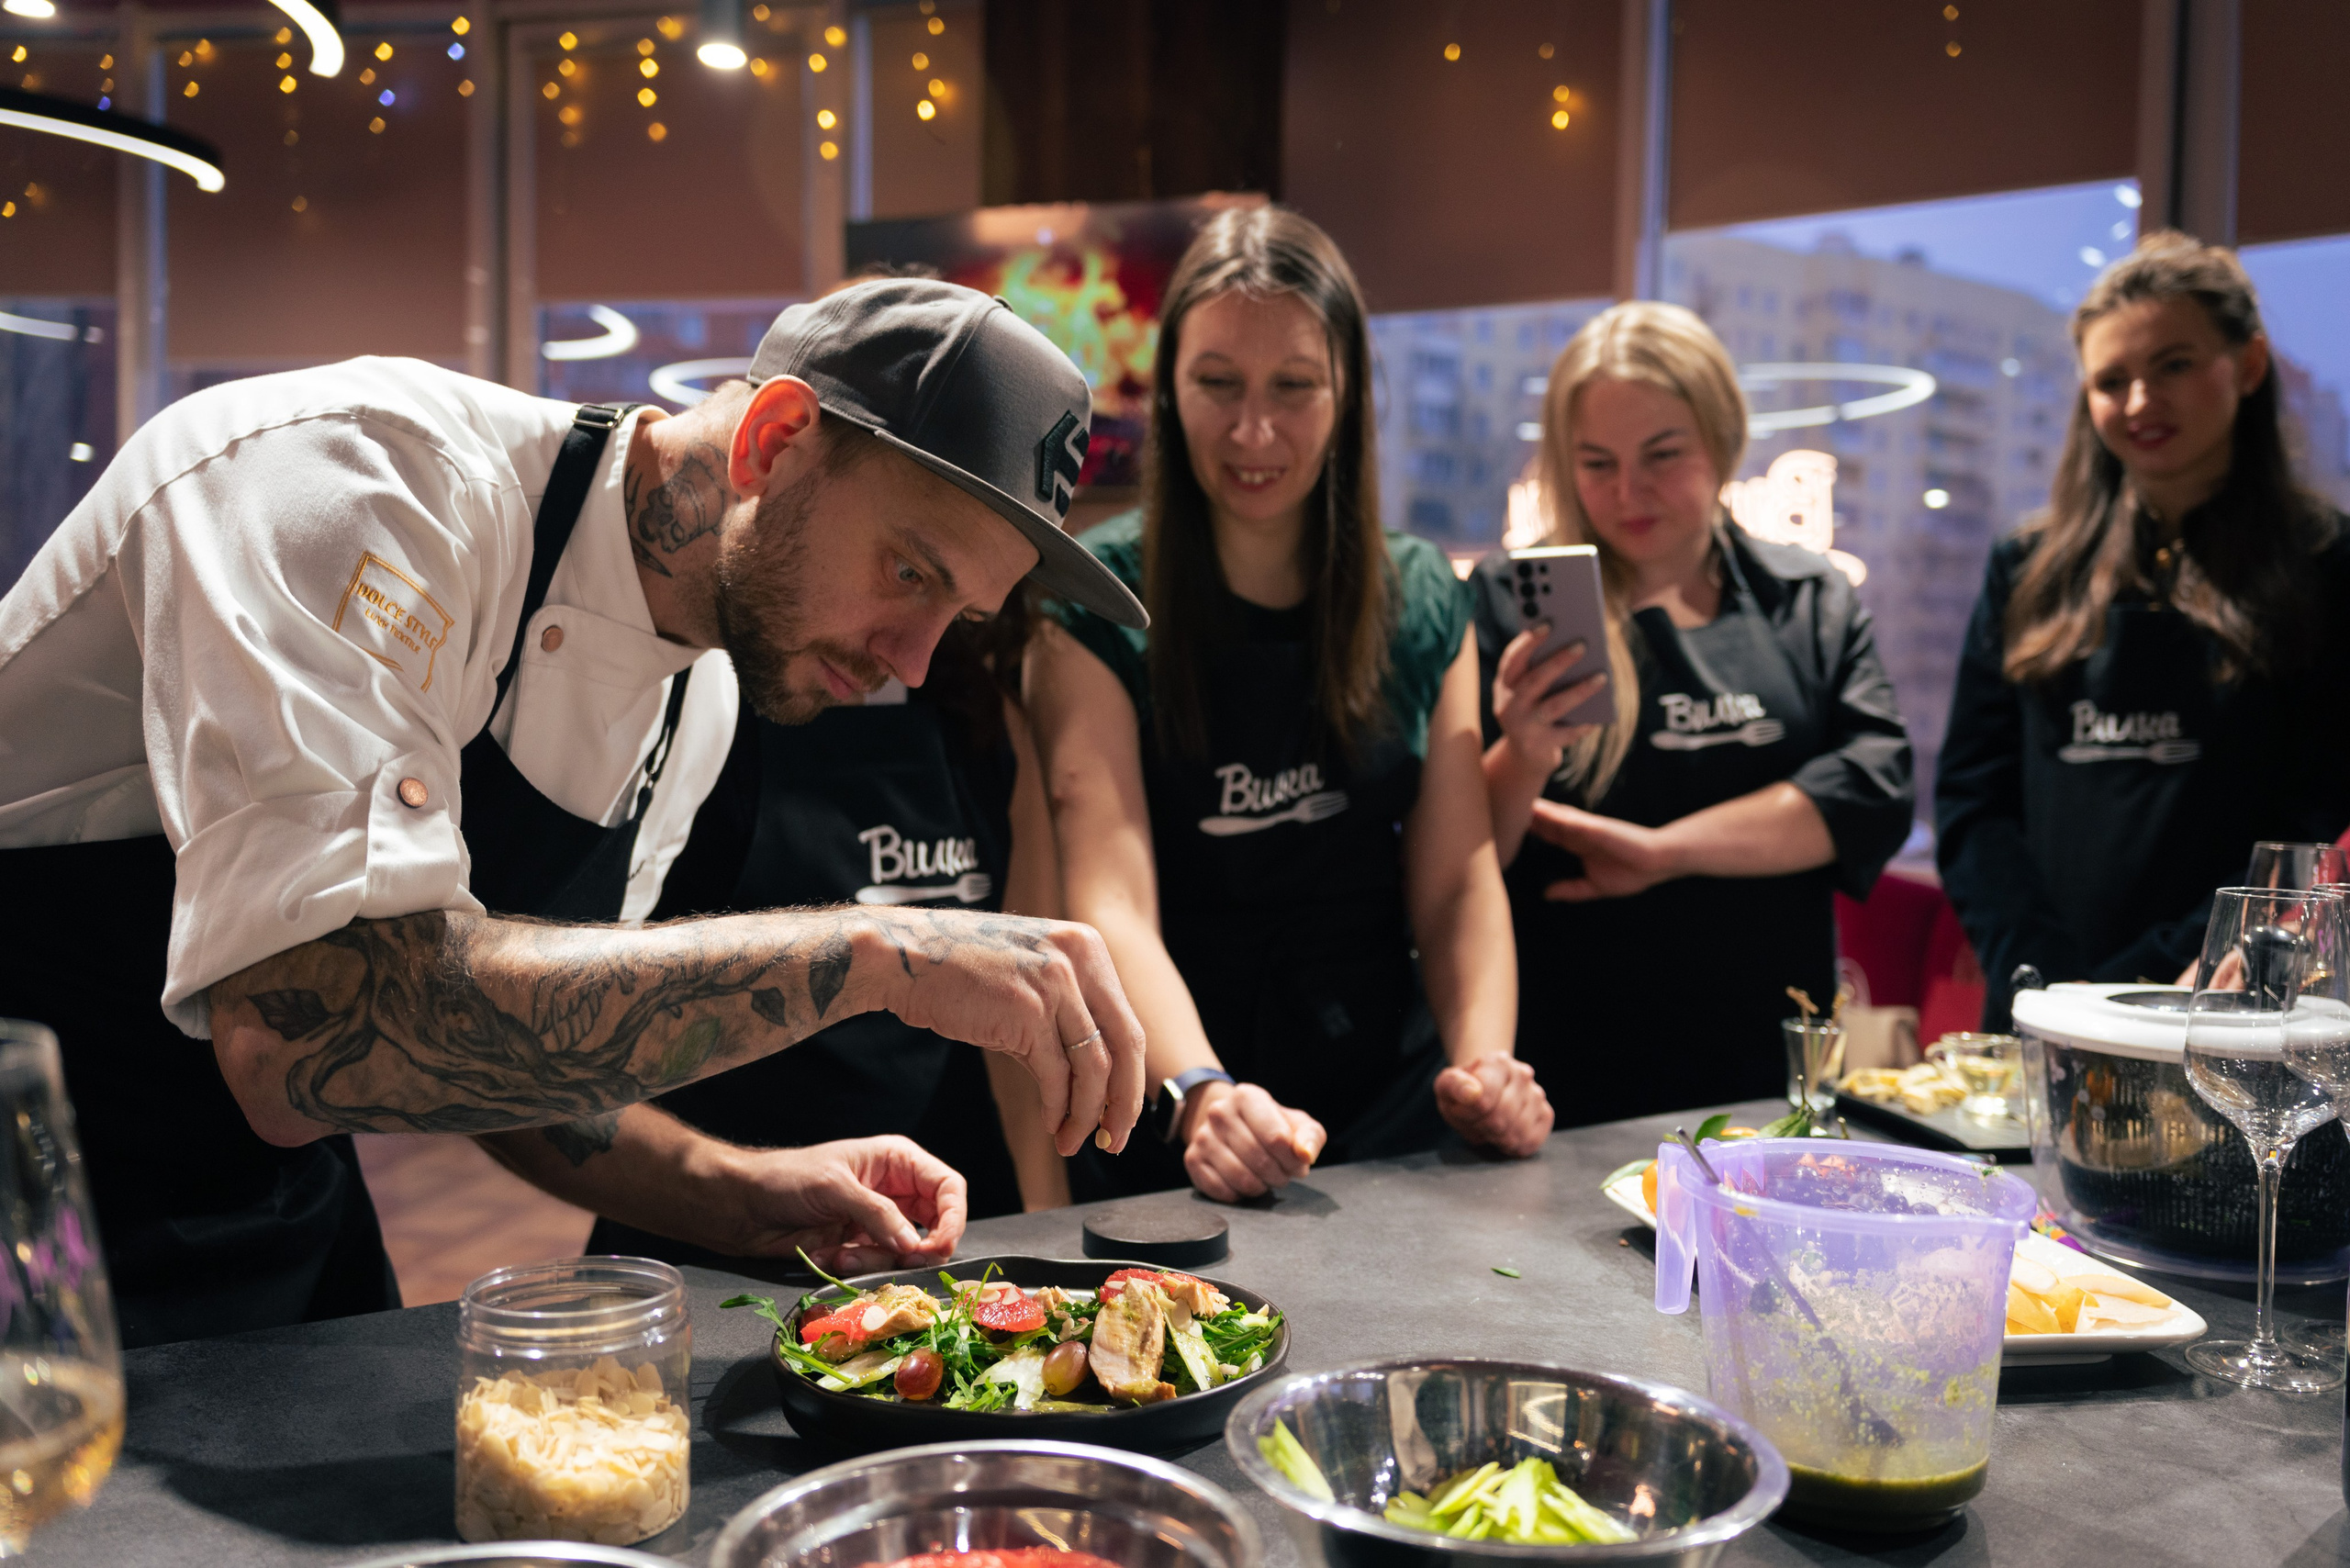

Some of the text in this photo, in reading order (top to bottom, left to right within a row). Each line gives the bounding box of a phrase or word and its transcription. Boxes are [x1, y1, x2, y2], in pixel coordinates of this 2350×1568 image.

[356, 583, 438, 649] DOLCE STYLE
[364, 607, 421, 654] LUXE TEXTILE
